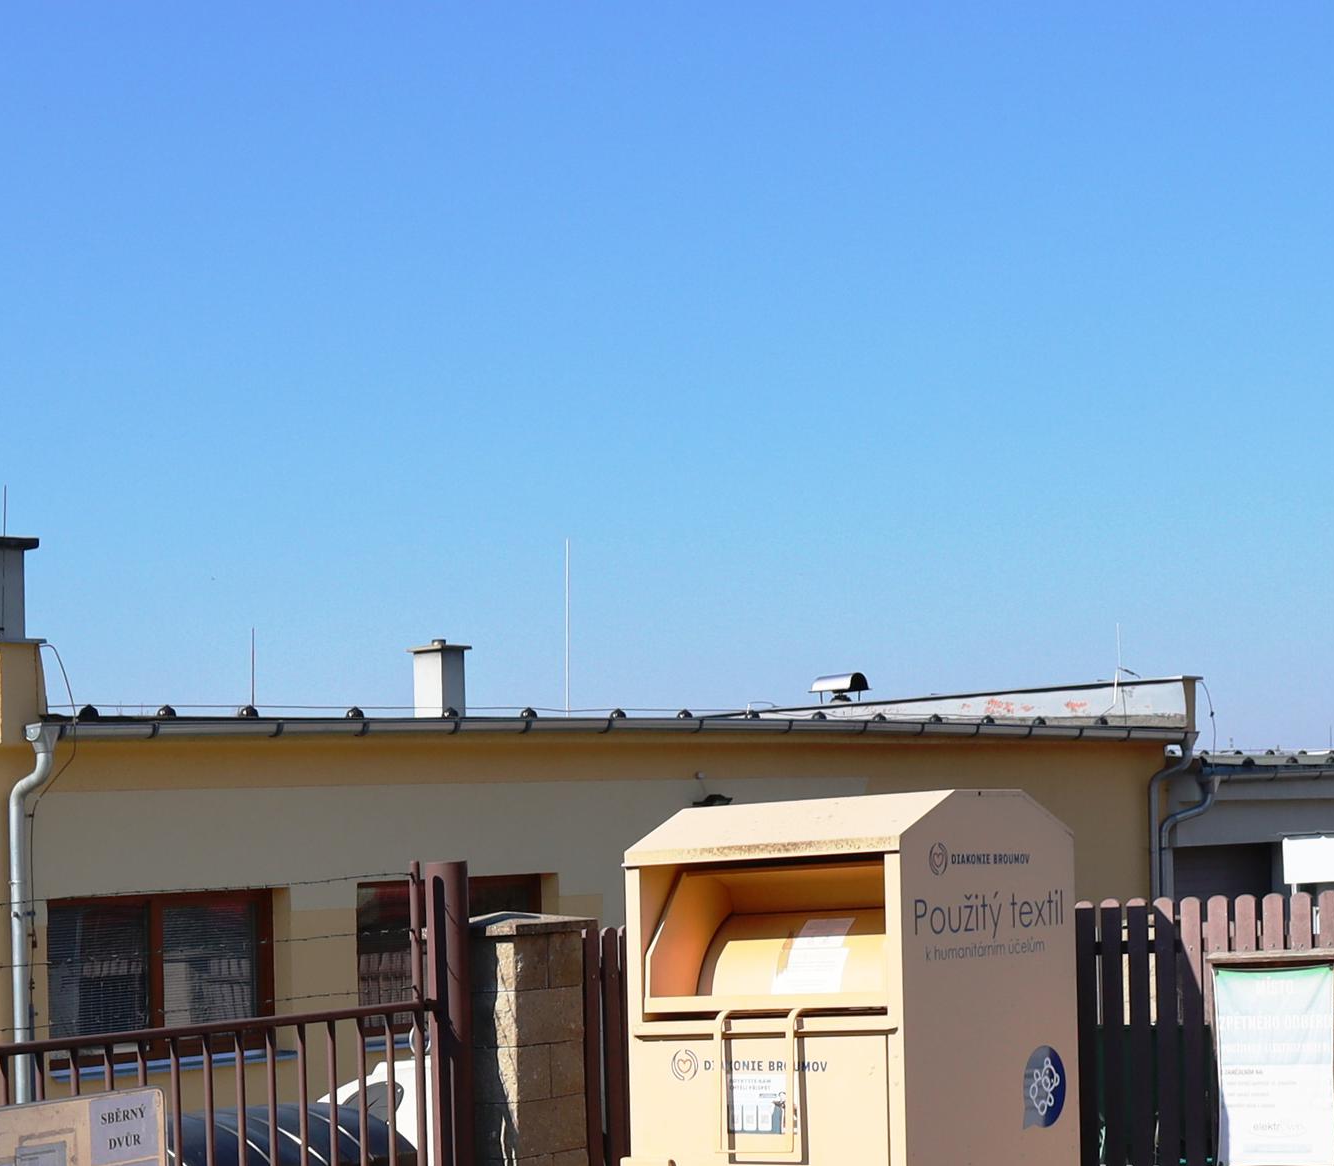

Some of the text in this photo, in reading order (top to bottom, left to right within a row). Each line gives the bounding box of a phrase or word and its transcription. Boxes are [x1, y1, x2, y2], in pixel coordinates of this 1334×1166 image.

[951, 854, 1031, 865] DIAKONIE BROUMOV
[914, 889, 1064, 939] Použitý textil
[925, 936, 1045, 961] k humanitárním účelům
[100, 1104, 147, 1126] SBĚRNÝ
[108, 1134, 141, 1150] DVŮR
